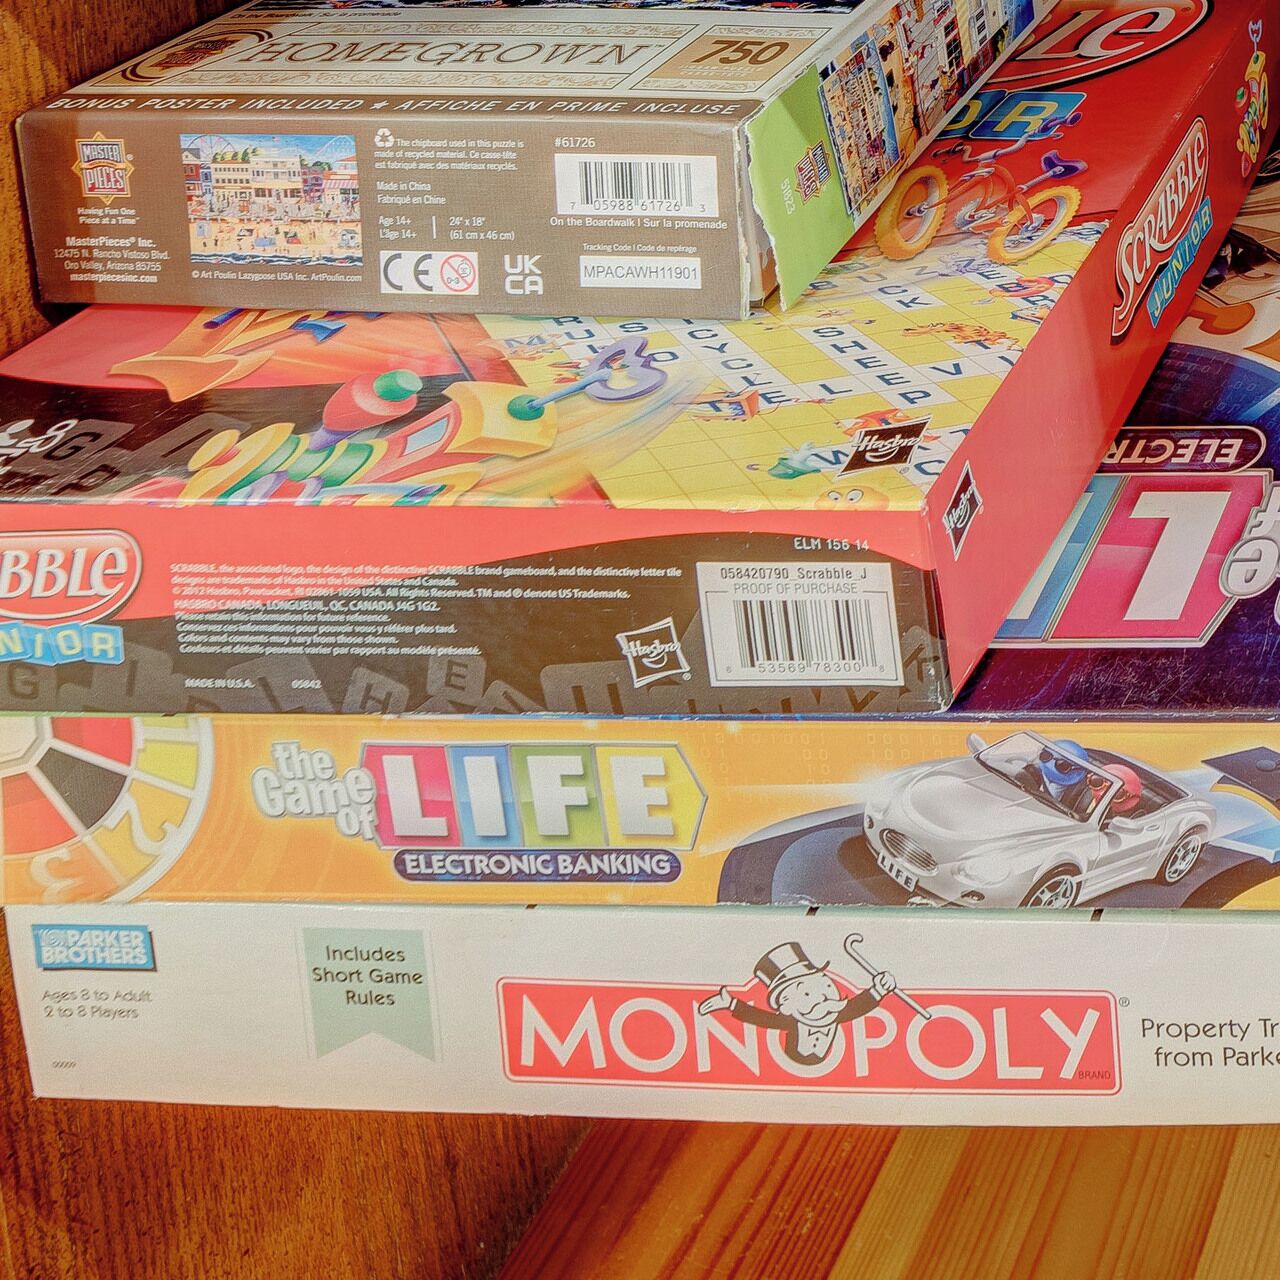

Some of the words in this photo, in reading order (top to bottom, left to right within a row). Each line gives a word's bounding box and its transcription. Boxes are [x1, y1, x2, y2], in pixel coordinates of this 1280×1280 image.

[240, 39, 640, 68] HOMEGROWN
[690, 38, 791, 67] 750
[45, 97, 136, 111] BONUS
[138, 97, 237, 111] POSTER
[242, 97, 364, 112] INCLUDED
[391, 98, 503, 113] AFFICHE
[506, 100, 545, 113] EN
[549, 100, 628, 114] PRIME
[632, 101, 742, 116] INCLUSE
[553, 136, 597, 149] #61726
[81, 144, 121, 163] MASTER
[85, 168, 125, 190] PIECES
[376, 180, 399, 192] Made
[399, 180, 408, 191] in
[408, 181, 432, 192] China
[780, 179, 796, 215] 51823
[549, 216, 565, 227] On
[566, 216, 584, 227] the
[585, 216, 636, 228] Boardwalk
[643, 218, 661, 229] Sur
[662, 219, 673, 229] la
[674, 219, 729, 232] promenade
[1117, 129, 1207, 322] SCRABBLE
[502, 254, 543, 275] UK
[1152, 204, 1213, 317] JUNIOR
[583, 264, 698, 281] MPACAWH11901
[503, 274, 544, 296] CA
[852, 431, 926, 457] Hasbro
[792, 536, 823, 551] ELM
[824, 537, 851, 552] 156
[854, 538, 870, 552] 14
[733, 582, 773, 594] PROOF
[775, 582, 792, 594] OF
[794, 582, 859, 594] PURCHASE
[622, 634, 681, 658] Hasbro
[271, 741, 337, 784] the
[251, 766, 378, 818] Game
[335, 810, 379, 841] of
[382, 754, 676, 837] LIFE
[403, 852, 554, 877] ELECTRONIC
[558, 853, 672, 877] BANKING
[66, 930, 143, 948] PARKER
[42, 946, 148, 967] BROTHERS
[326, 945, 406, 963] Includes
[311, 967, 364, 984] Short
[368, 968, 424, 986] Game
[345, 989, 397, 1007] Rules
[1141, 1017, 1251, 1041] Property
[1154, 1046, 1214, 1067] from
